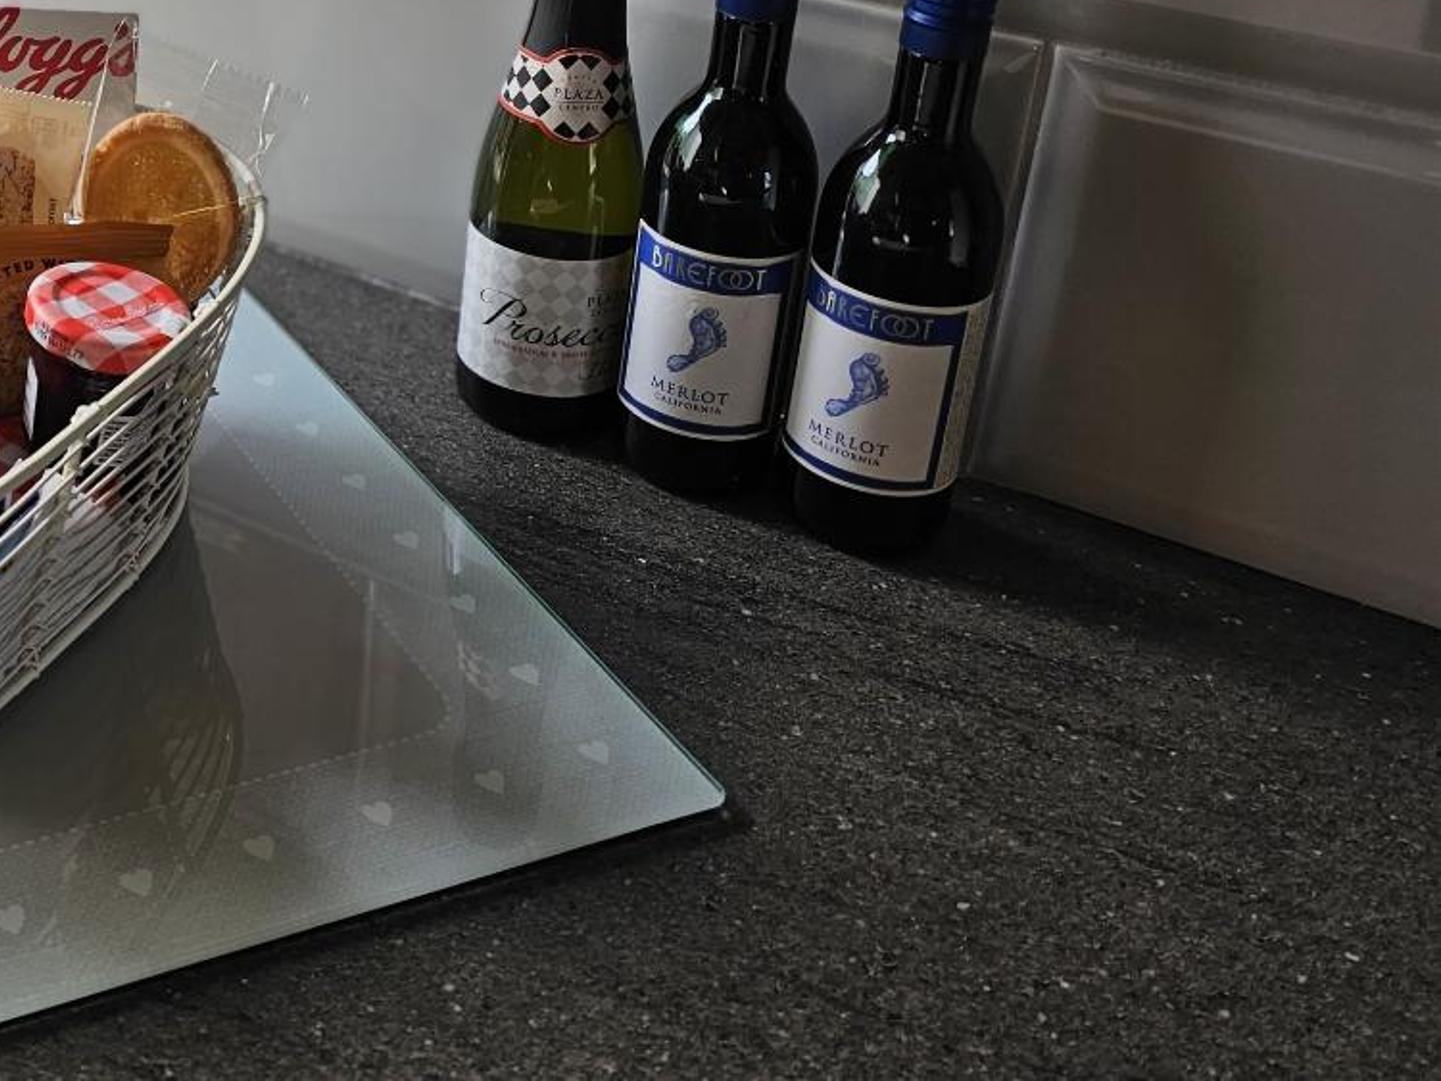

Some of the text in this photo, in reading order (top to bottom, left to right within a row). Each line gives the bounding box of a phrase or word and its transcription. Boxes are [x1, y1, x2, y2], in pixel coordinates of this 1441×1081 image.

[555, 87, 604, 101] PLAZA
[652, 245, 767, 291] BAREFOOT
[816, 284, 936, 341] BAREFOOT
[651, 375, 729, 406] MERLOT
[653, 390, 722, 415] CALIFORNIA
[808, 419, 890, 458] MERLOT
[810, 434, 880, 467] CALIFORNIA
